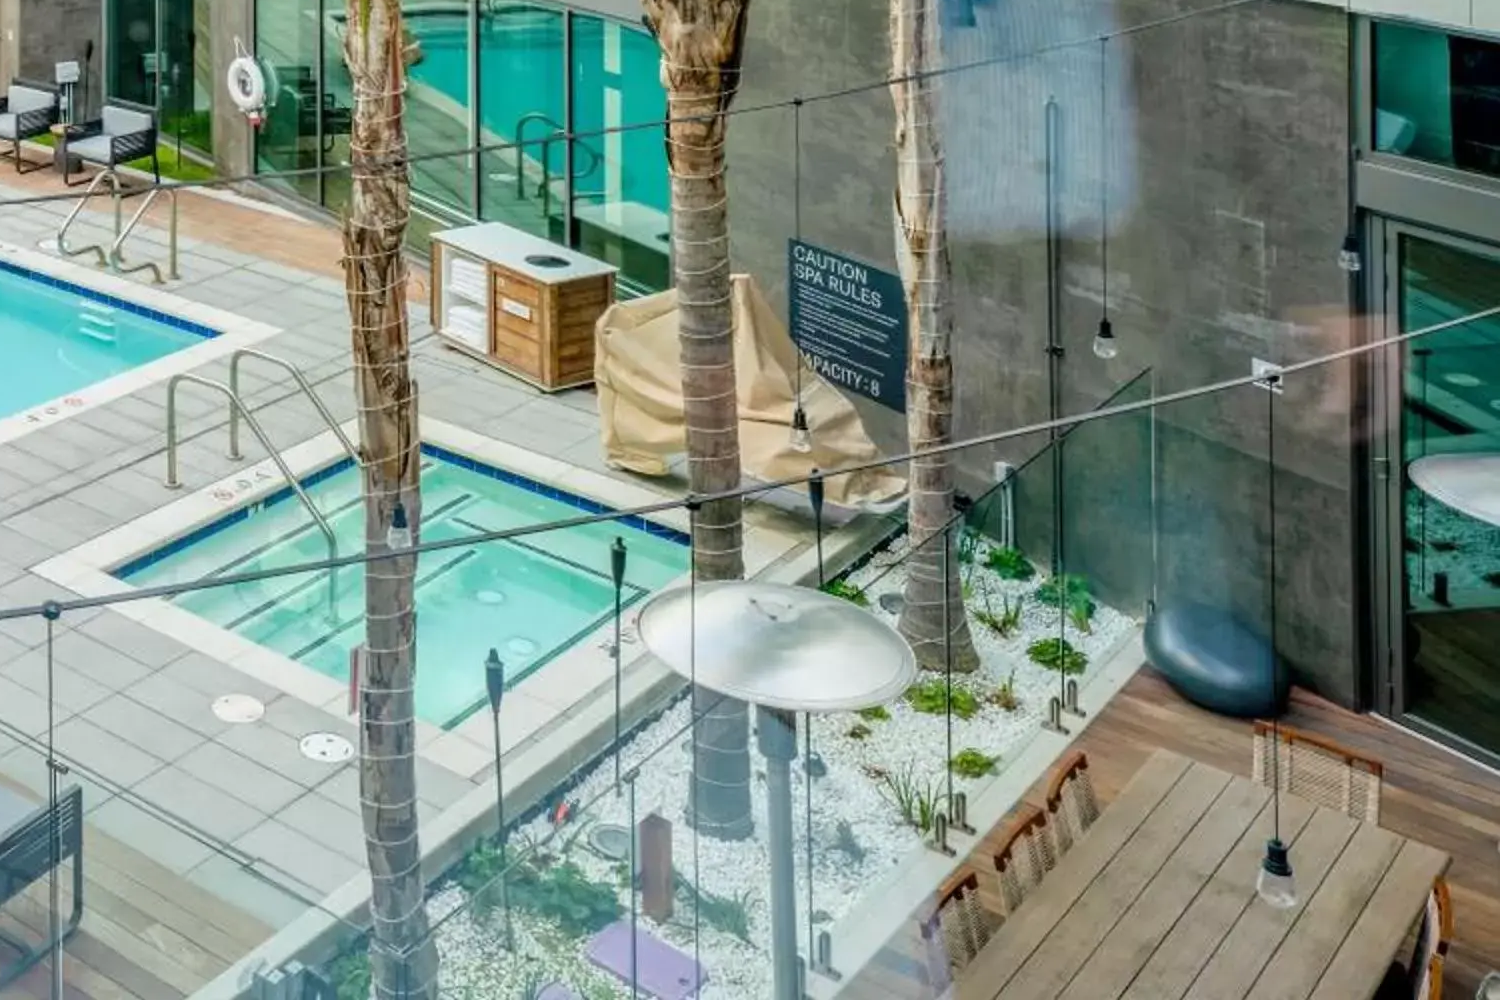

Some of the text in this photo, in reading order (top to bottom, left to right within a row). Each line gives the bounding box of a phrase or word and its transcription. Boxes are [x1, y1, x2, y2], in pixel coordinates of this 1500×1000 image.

[794, 245, 867, 285] CAUTION
[794, 263, 825, 287] SPA
[828, 275, 883, 309] RULES
